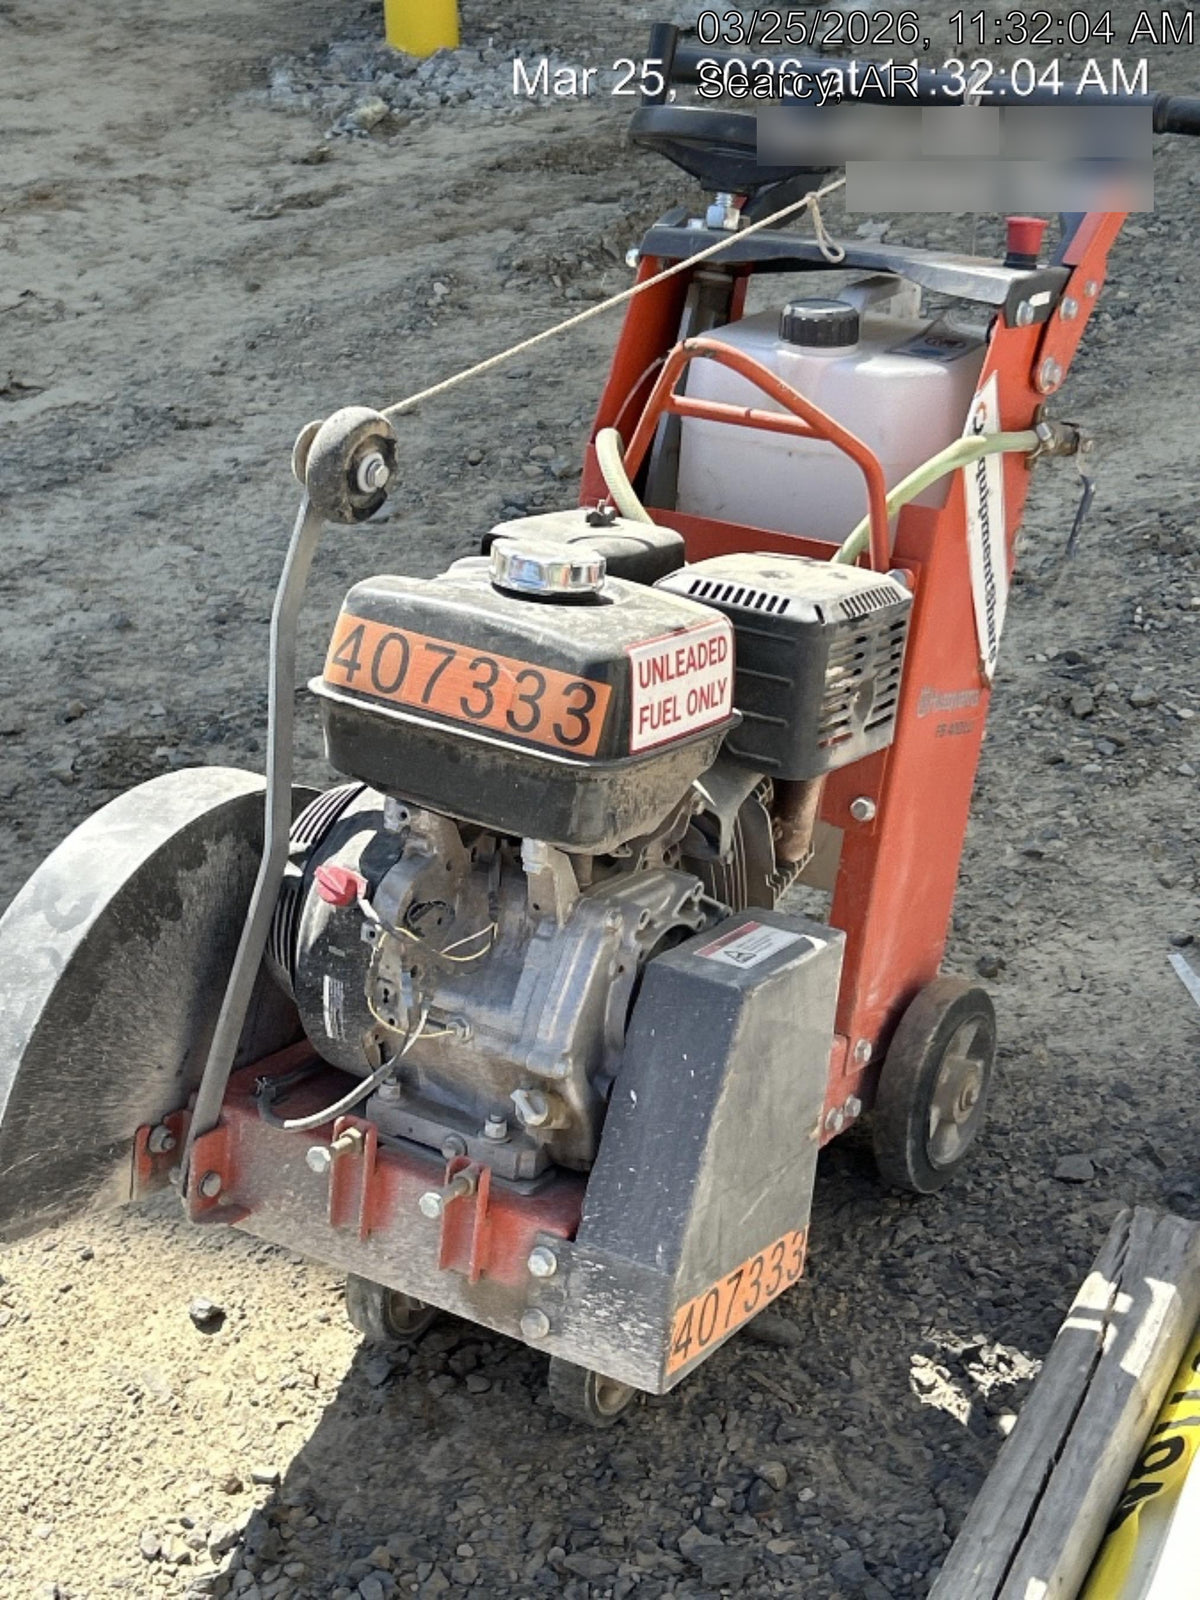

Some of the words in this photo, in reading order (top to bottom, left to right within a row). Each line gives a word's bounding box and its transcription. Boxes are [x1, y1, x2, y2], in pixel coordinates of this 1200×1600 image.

[974, 452, 997, 664] quipmentShare
[331, 623, 597, 748] 407333
[638, 635, 728, 689] UNLEADED
[638, 694, 682, 735] FUEL
[686, 677, 728, 716] ONLY
[672, 1229, 806, 1359] 407333
